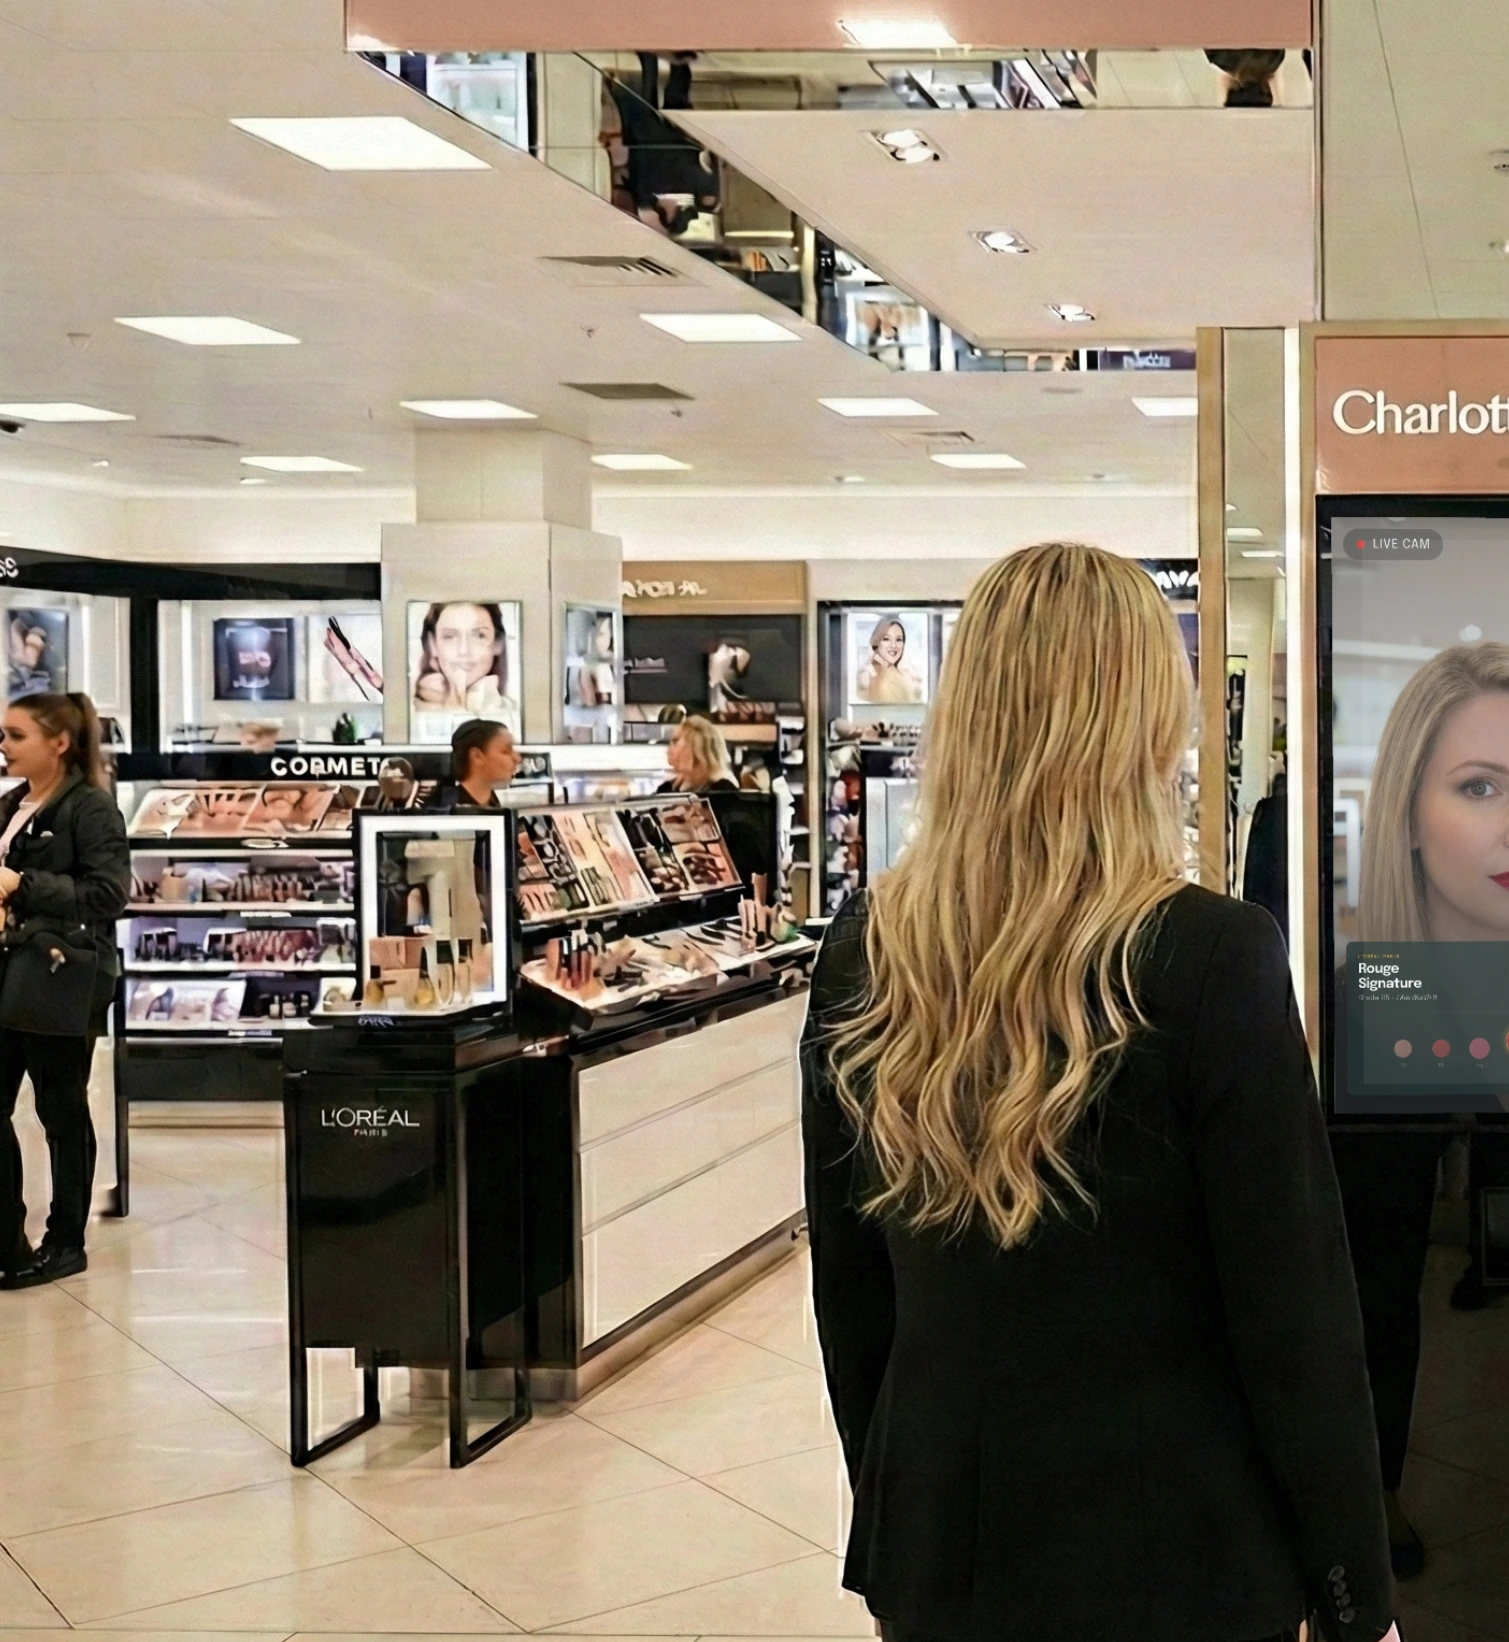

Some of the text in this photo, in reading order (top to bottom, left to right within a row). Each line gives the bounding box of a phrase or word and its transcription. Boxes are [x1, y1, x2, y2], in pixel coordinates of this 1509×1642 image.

[1372, 538, 1430, 549] LIVE CAM
[1358, 962, 1400, 977] Rouge
[1358, 977, 1422, 992] Signature
[321, 1105, 420, 1128] L'ORÉAL
